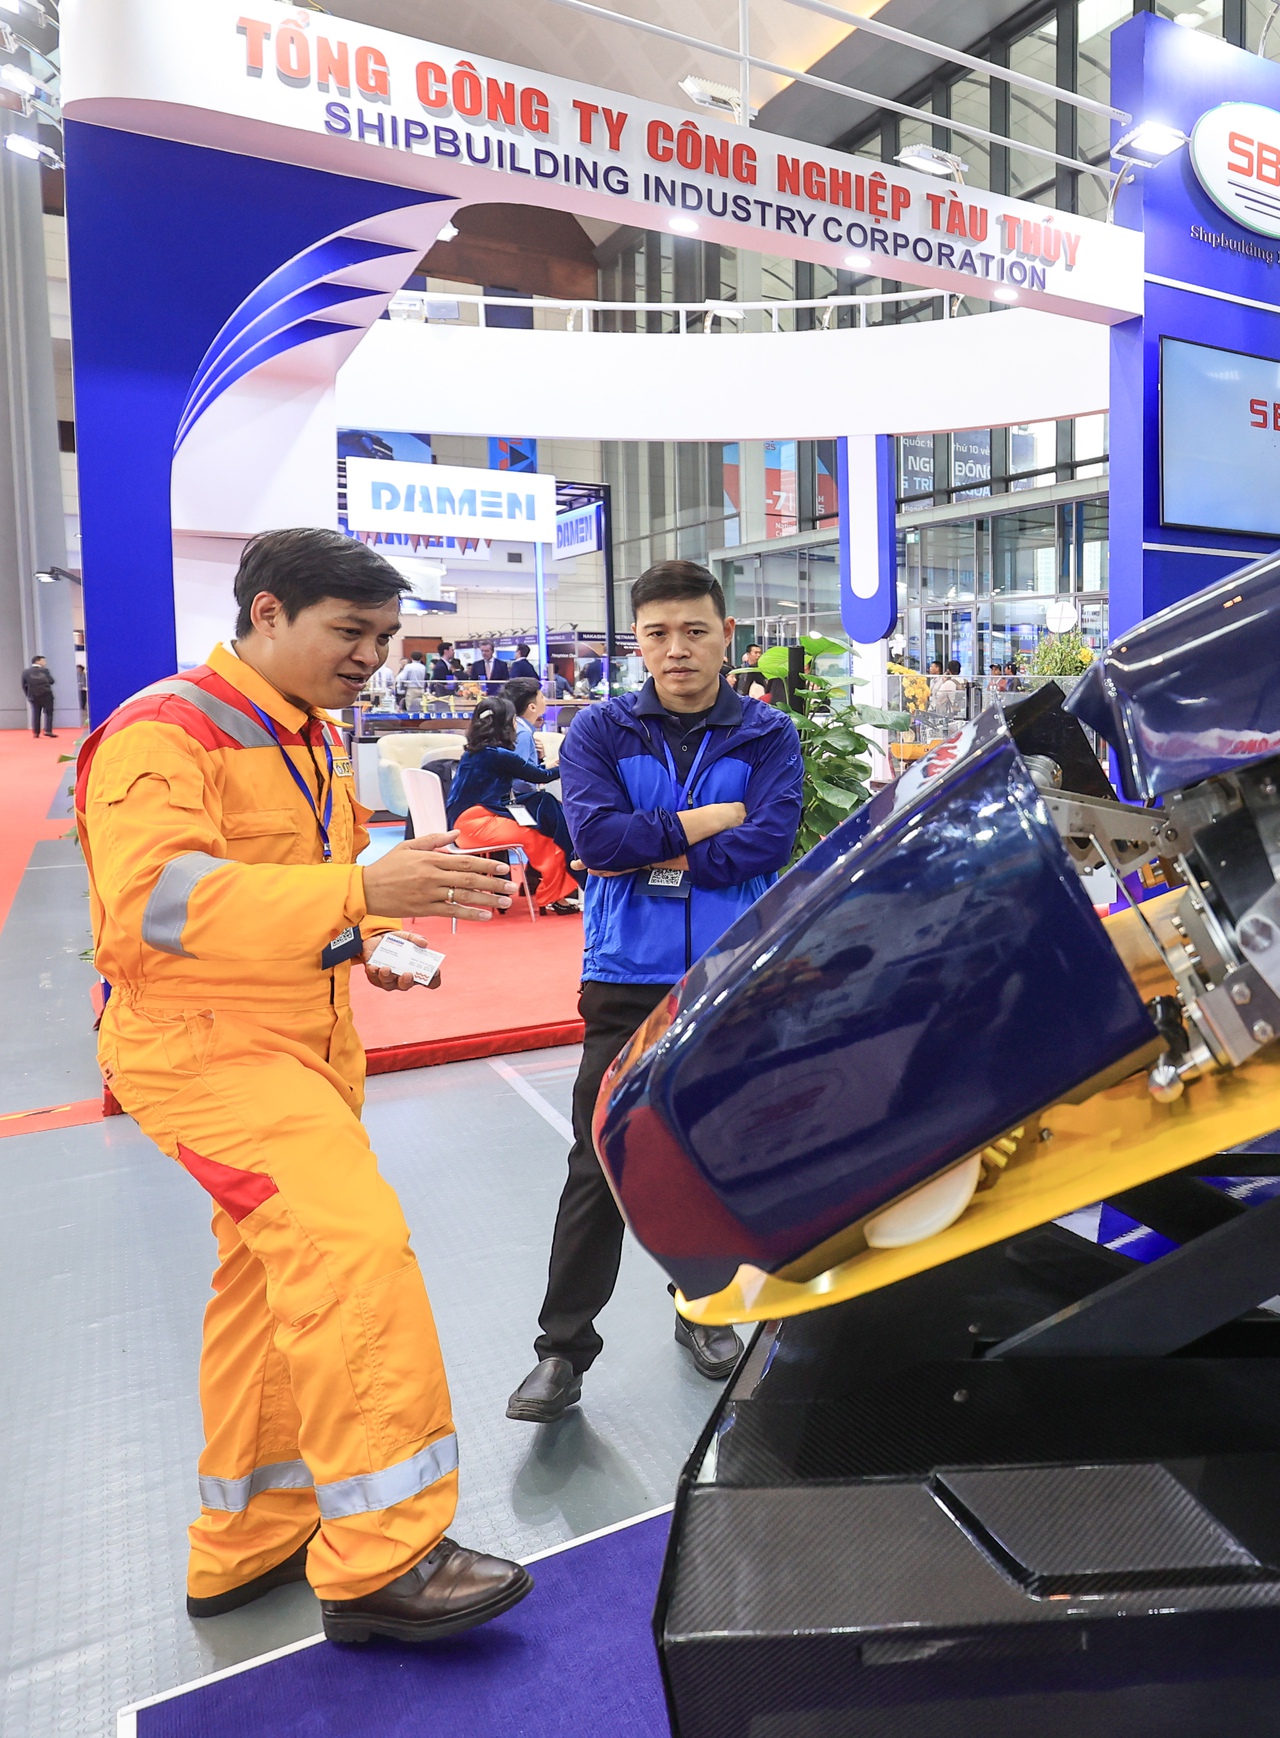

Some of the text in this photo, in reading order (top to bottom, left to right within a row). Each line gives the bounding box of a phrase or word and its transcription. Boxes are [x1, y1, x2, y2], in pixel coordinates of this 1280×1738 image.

[237, 10, 389, 97] TỔNG
[415, 59, 549, 134] CÔNG
[572, 99, 628, 151] TY
[646, 120, 757, 185] CÔNG
[777, 154, 911, 224] NGHIỆP
[926, 189, 988, 242] TÀU
[324, 101, 1046, 290] SHIPBUILDING INDUSTRY CORPORATION
[1190, 224, 1273, 263] Shipbuilding
[969, 445, 978, 454] 10
[371, 481, 536, 521] DAMEN
[556, 514, 593, 549] DAMEN
